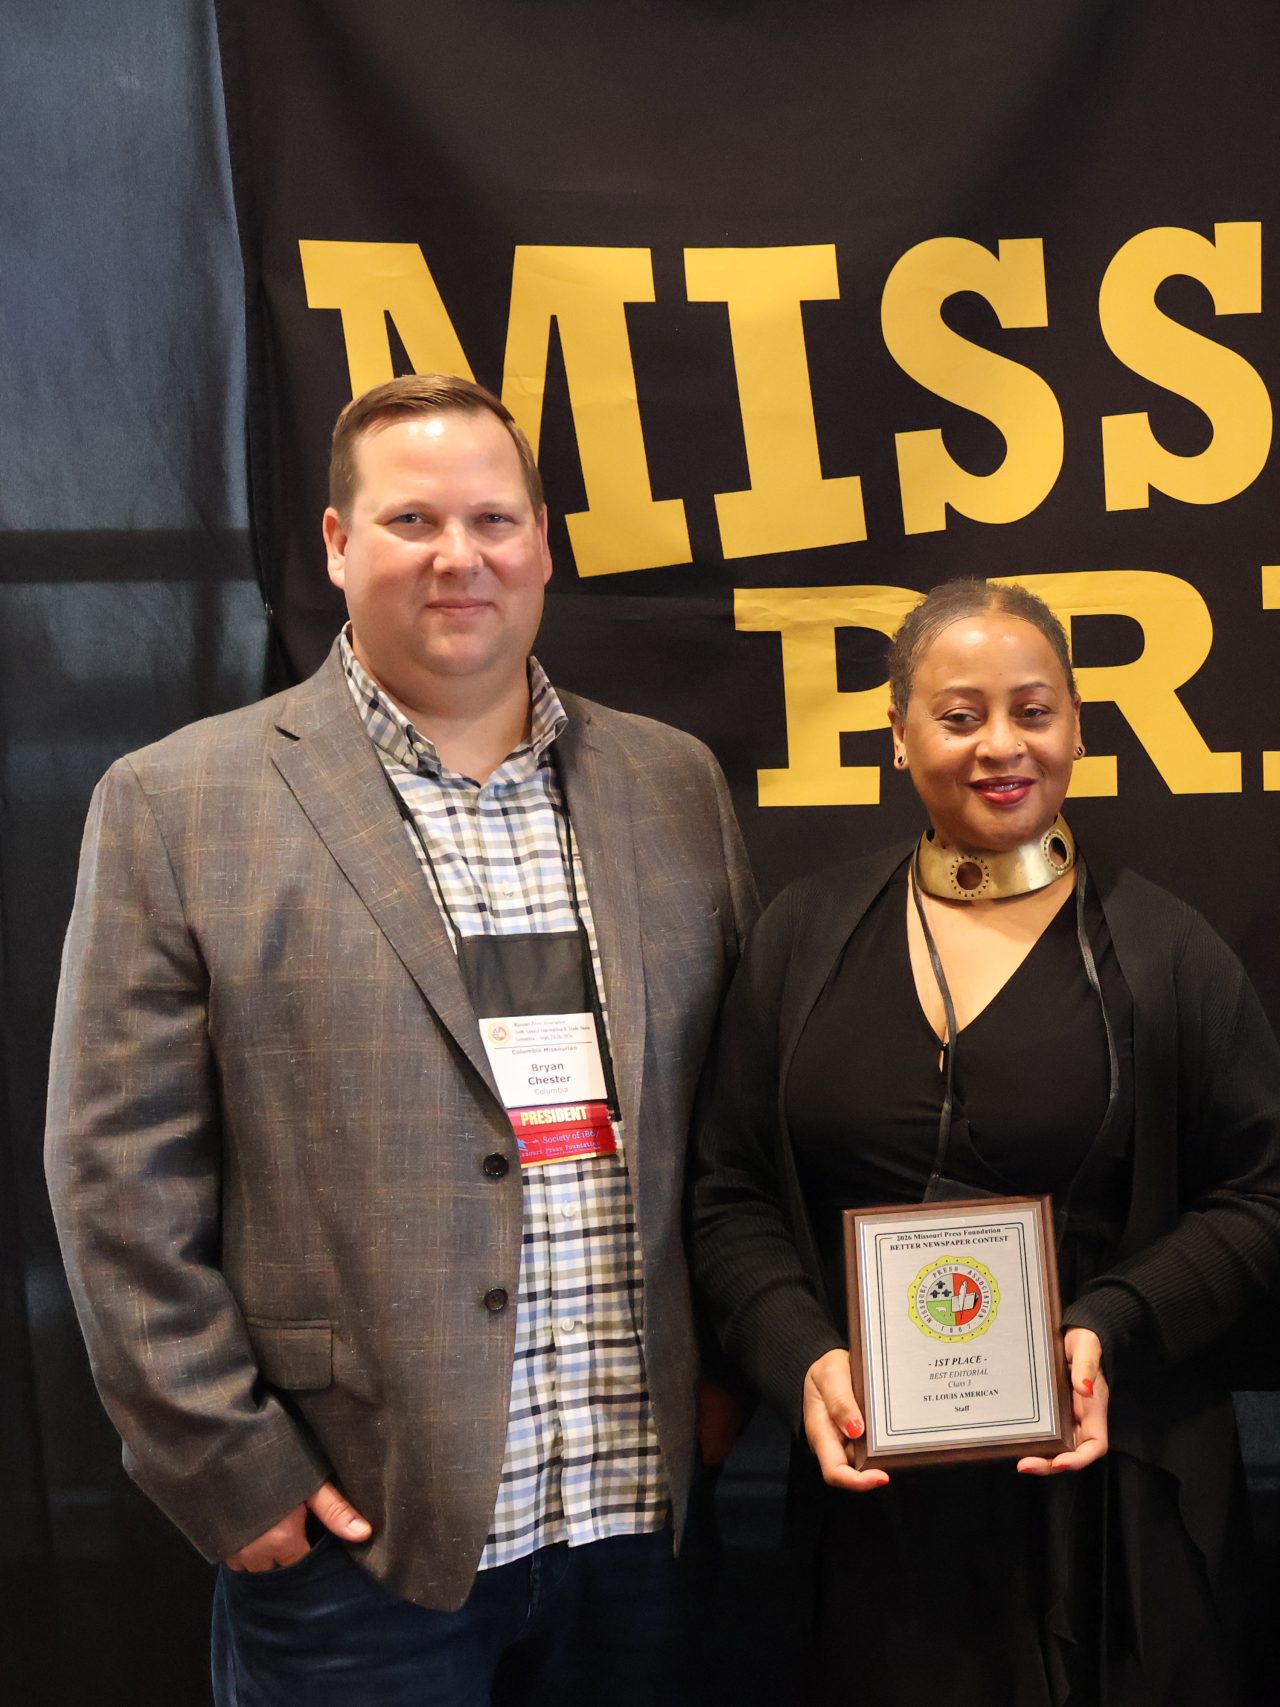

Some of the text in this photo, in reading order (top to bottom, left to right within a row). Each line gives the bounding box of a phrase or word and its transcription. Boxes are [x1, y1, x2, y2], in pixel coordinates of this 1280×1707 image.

[531, 1062, 564, 1074] Bryan
[528, 1076, 571, 1086] Chester
[534, 1087, 569, 1095] Columbia
[520, 1106, 587, 1126] PRESIDENT
[542, 1134, 571, 1144] Society
[572, 1131, 580, 1140] of
[896, 1233, 912, 1241] 2026
[913, 1232, 943, 1240] Missouri
[963, 1227, 1001, 1236] Foundation
[890, 1235, 1009, 1251] BETTER NEWSPAPER CONTEST
[918, 1284, 933, 1324] MISSOURI
[932, 1266, 959, 1278] PRESS
[934, 1358, 950, 1367] 1ST
[951, 1355, 982, 1366] PLACE
[929, 1368, 989, 1380] BEST EDITORIAL
[948, 1380, 966, 1388] Class
[935, 1392, 958, 1401] LOUIS
[959, 1389, 999, 1399] AMERICAN
